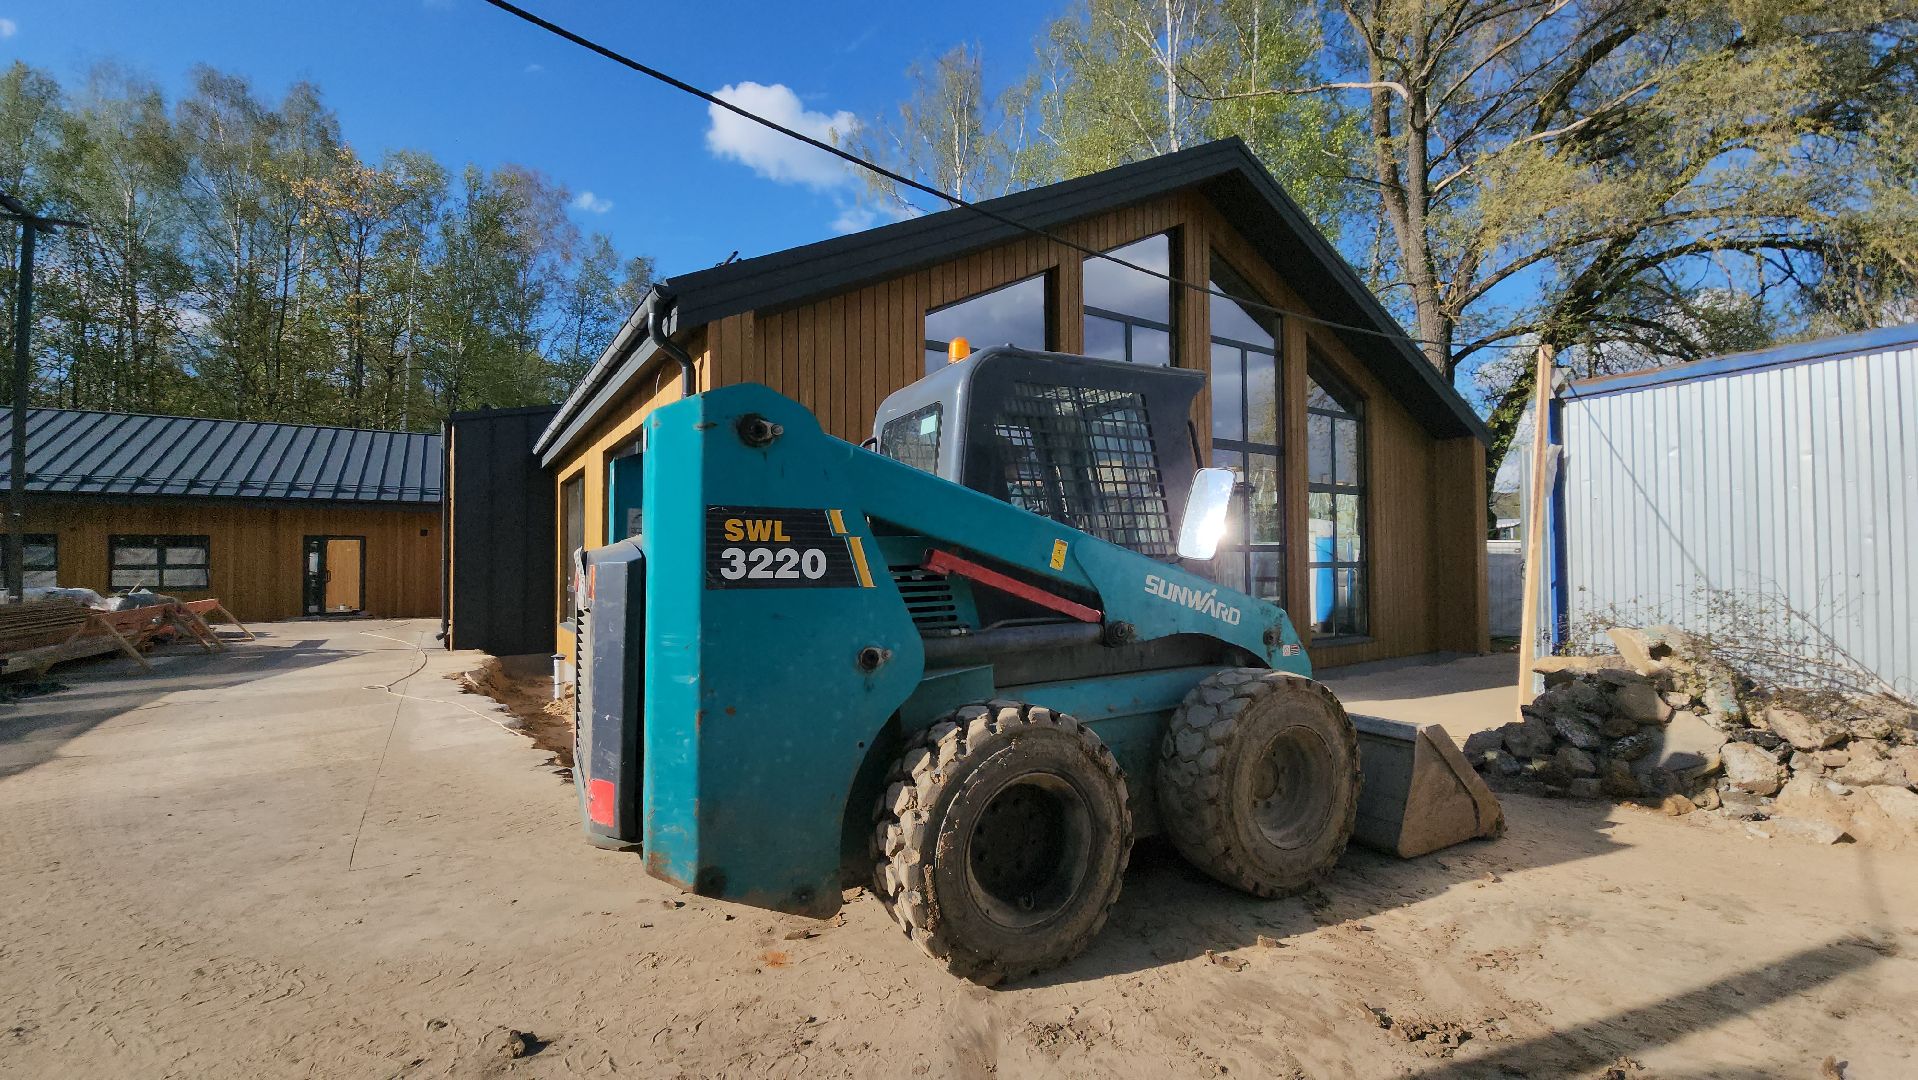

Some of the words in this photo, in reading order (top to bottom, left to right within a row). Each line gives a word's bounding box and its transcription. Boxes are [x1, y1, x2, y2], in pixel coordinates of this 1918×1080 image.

[724, 518, 791, 542] SWL
[720, 547, 827, 580] 3220
[1144, 574, 1241, 626] SUNWARD
